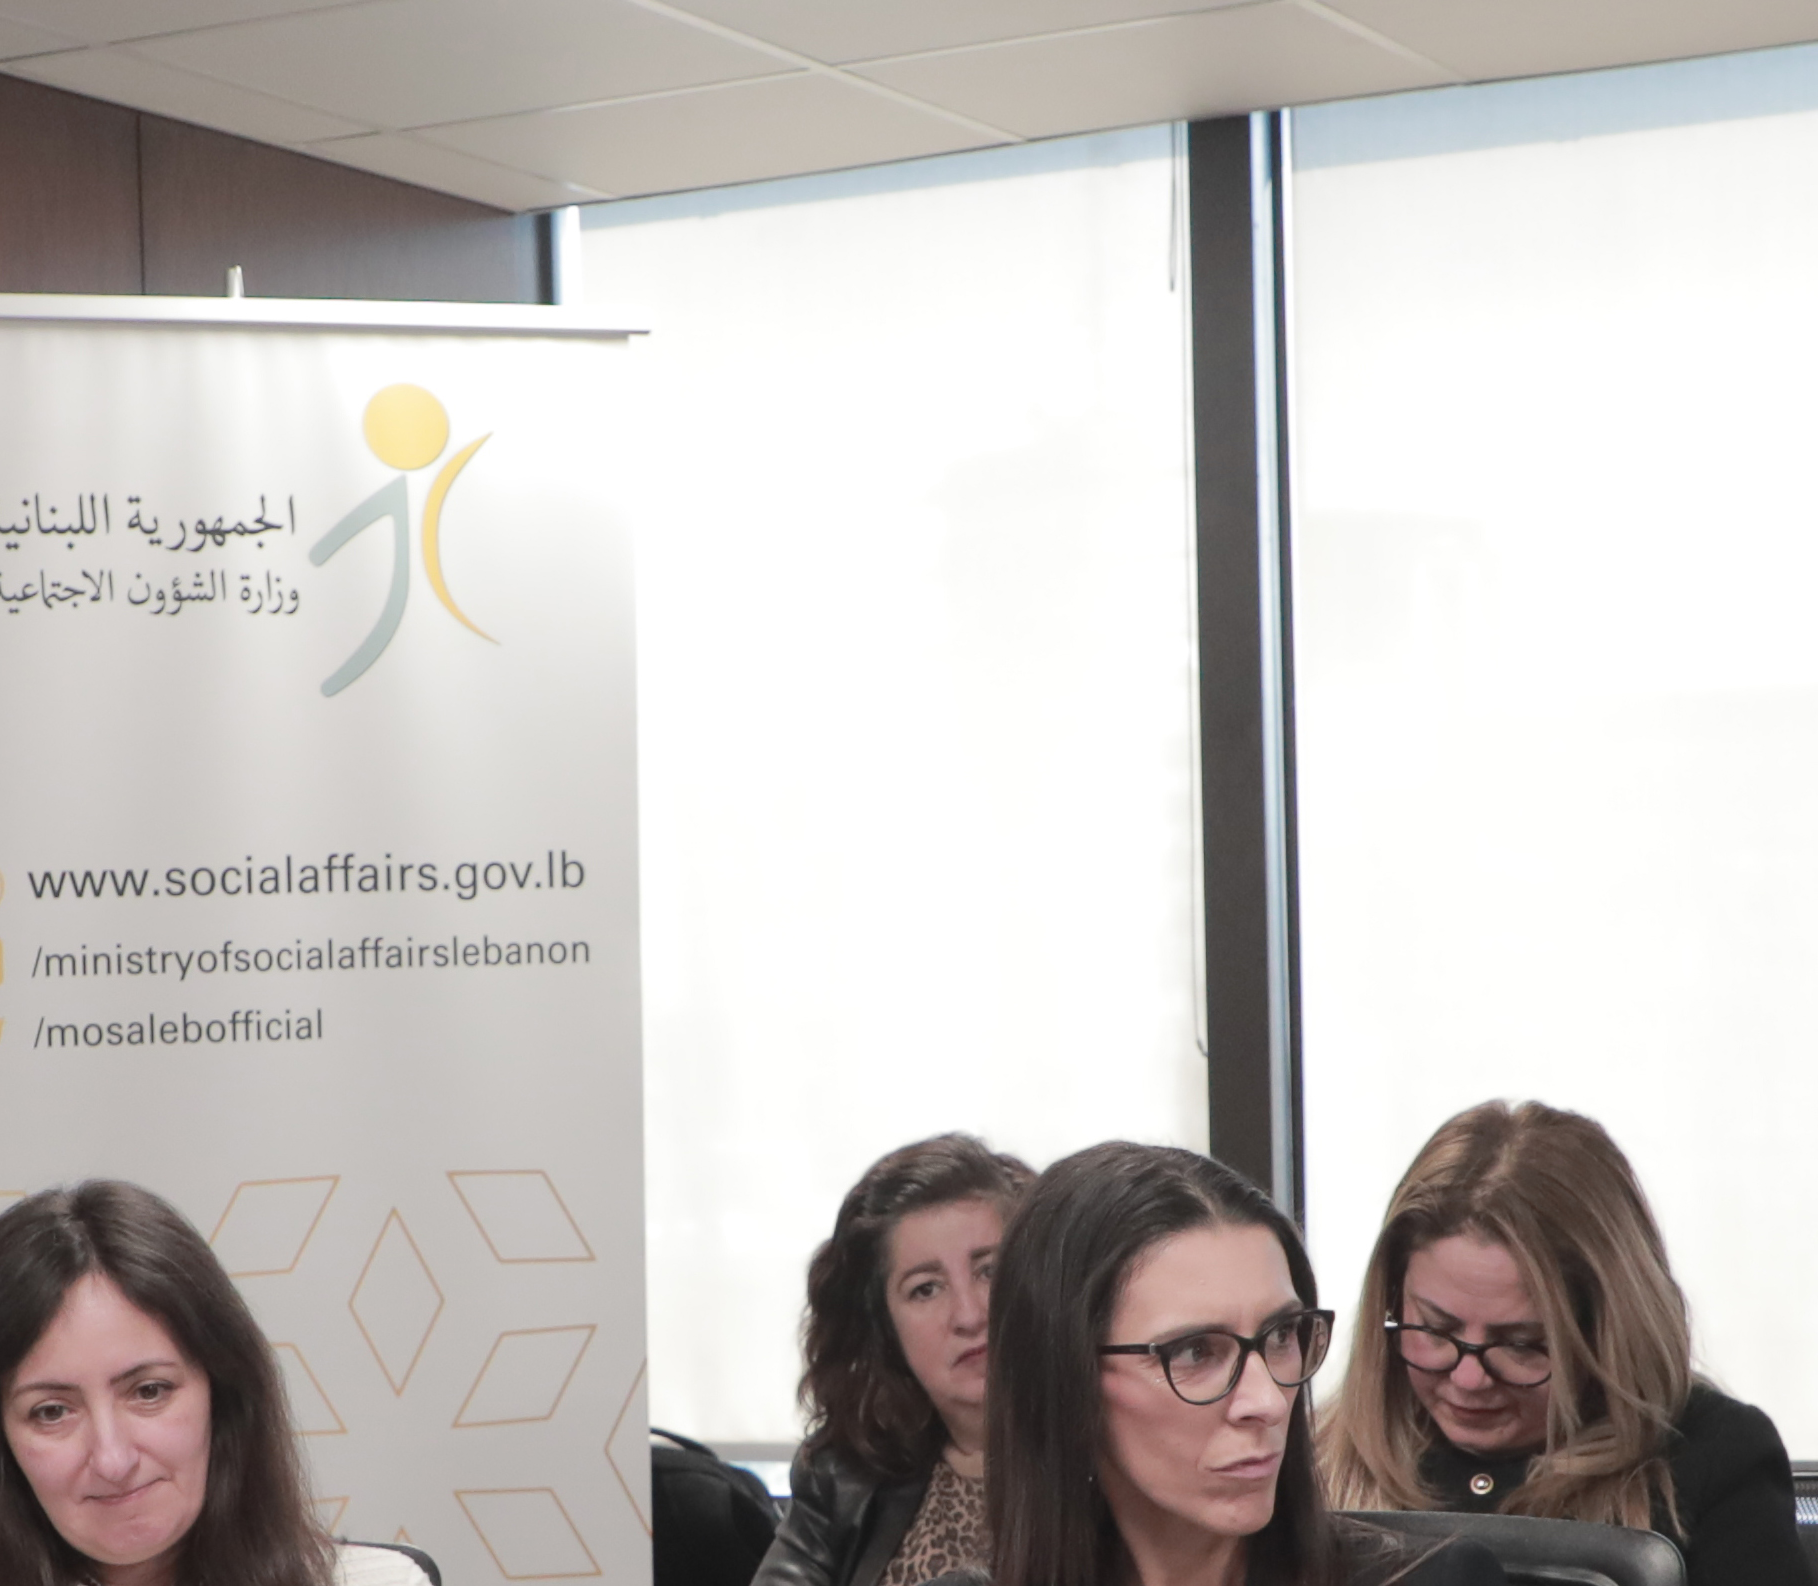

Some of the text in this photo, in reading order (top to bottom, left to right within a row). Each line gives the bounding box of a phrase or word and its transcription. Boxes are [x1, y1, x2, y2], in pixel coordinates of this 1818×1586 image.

[127, 495, 294, 553] الجمهورية
[128, 570, 225, 616] الشؤون
[240, 571, 299, 615] وزارة
[28, 851, 584, 900] www.socialaffairs.gov.lb
[32, 936, 589, 981] /ministryofsocialaffairslebanon
[34, 1009, 321, 1048] /mosalebofficial
